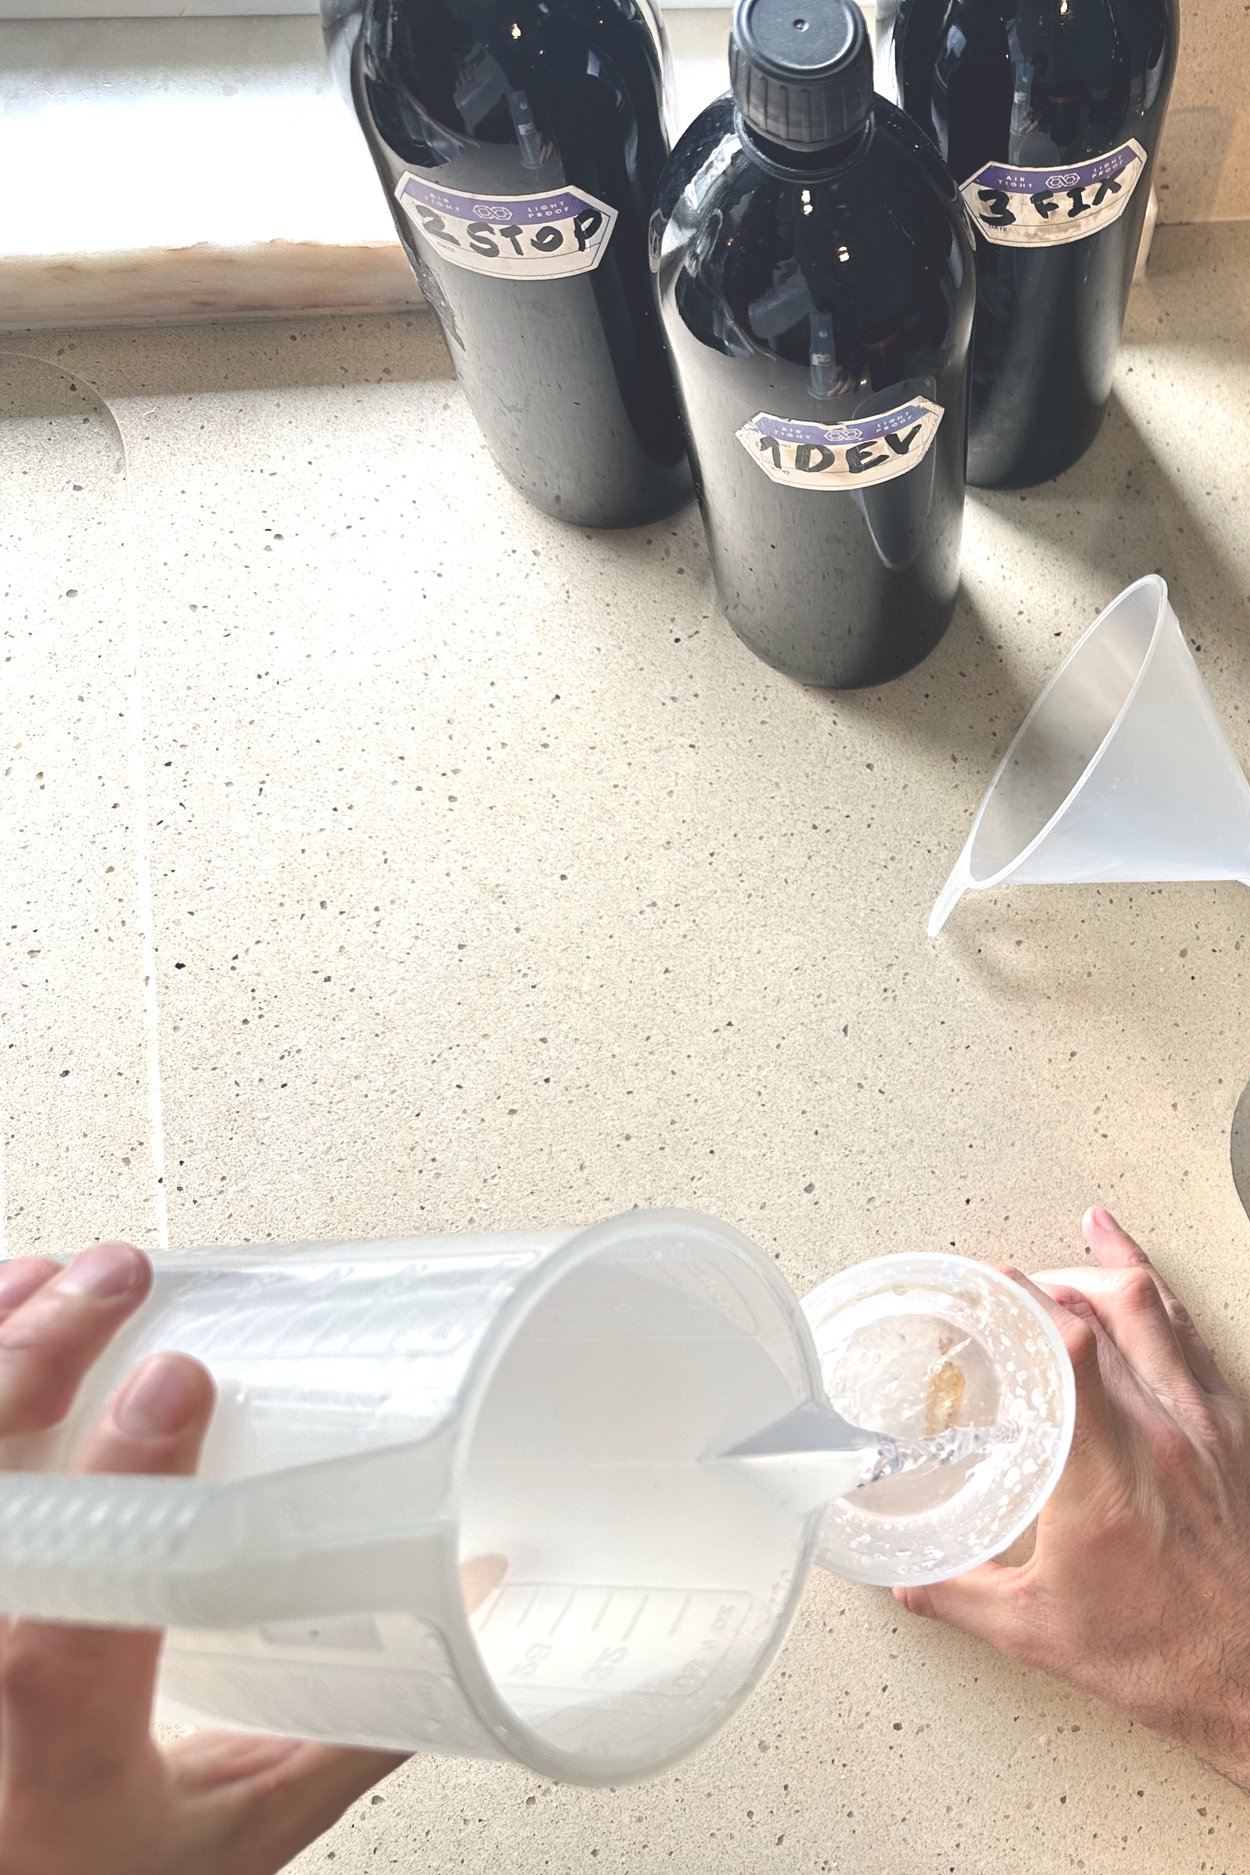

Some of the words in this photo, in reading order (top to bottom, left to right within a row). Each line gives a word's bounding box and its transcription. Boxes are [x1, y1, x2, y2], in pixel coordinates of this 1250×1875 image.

[998, 179, 1033, 188] TIGHT
[977, 189, 1017, 227] 3
[1030, 166, 1126, 219] FIX
[527, 201, 565, 213] LIGHT
[527, 206, 570, 219] PROOF
[416, 204, 461, 247] 2
[467, 209, 603, 258] STOP
[877, 411, 911, 428] LIGHT
[774, 429, 811, 440] TIGHT
